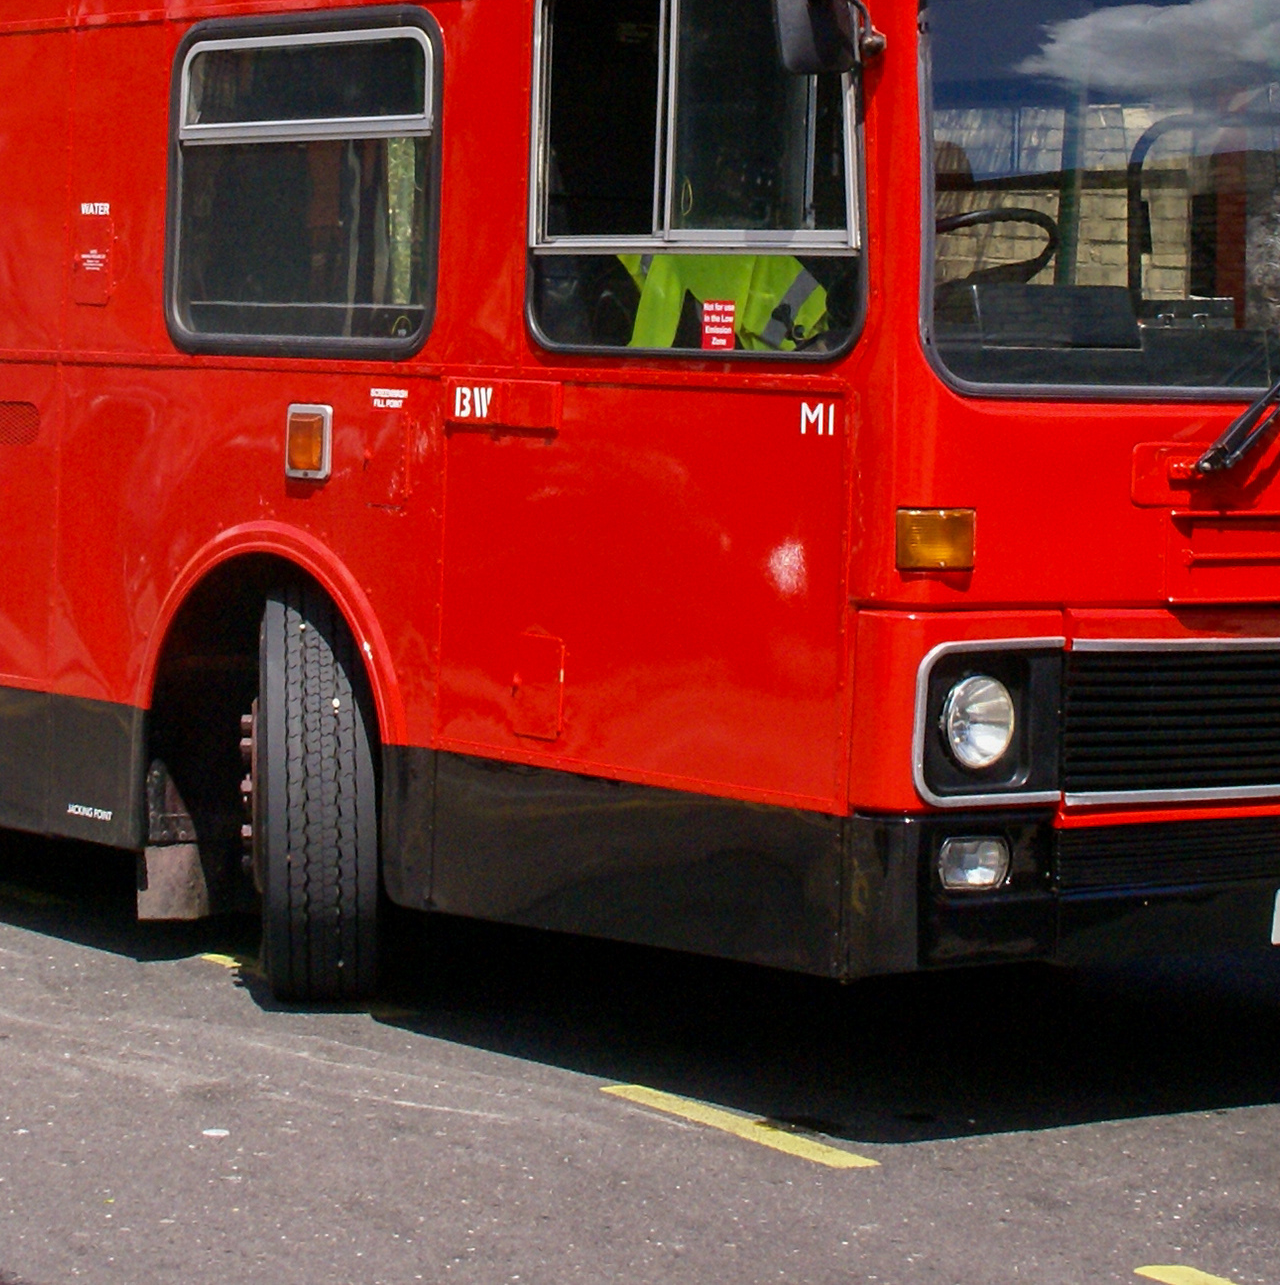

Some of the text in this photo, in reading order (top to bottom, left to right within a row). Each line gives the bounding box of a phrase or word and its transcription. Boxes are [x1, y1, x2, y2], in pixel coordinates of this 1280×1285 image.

[80, 202, 110, 216] WATER
[703, 303, 714, 311] Not
[715, 303, 723, 311] for
[703, 314, 734, 323] in the Low
[705, 325, 732, 334] Emission
[711, 336, 727, 346] Zone
[373, 398, 403, 409] FILL POINT
[454, 386, 493, 418] BW
[67, 803, 113, 821] JACKING POINT
